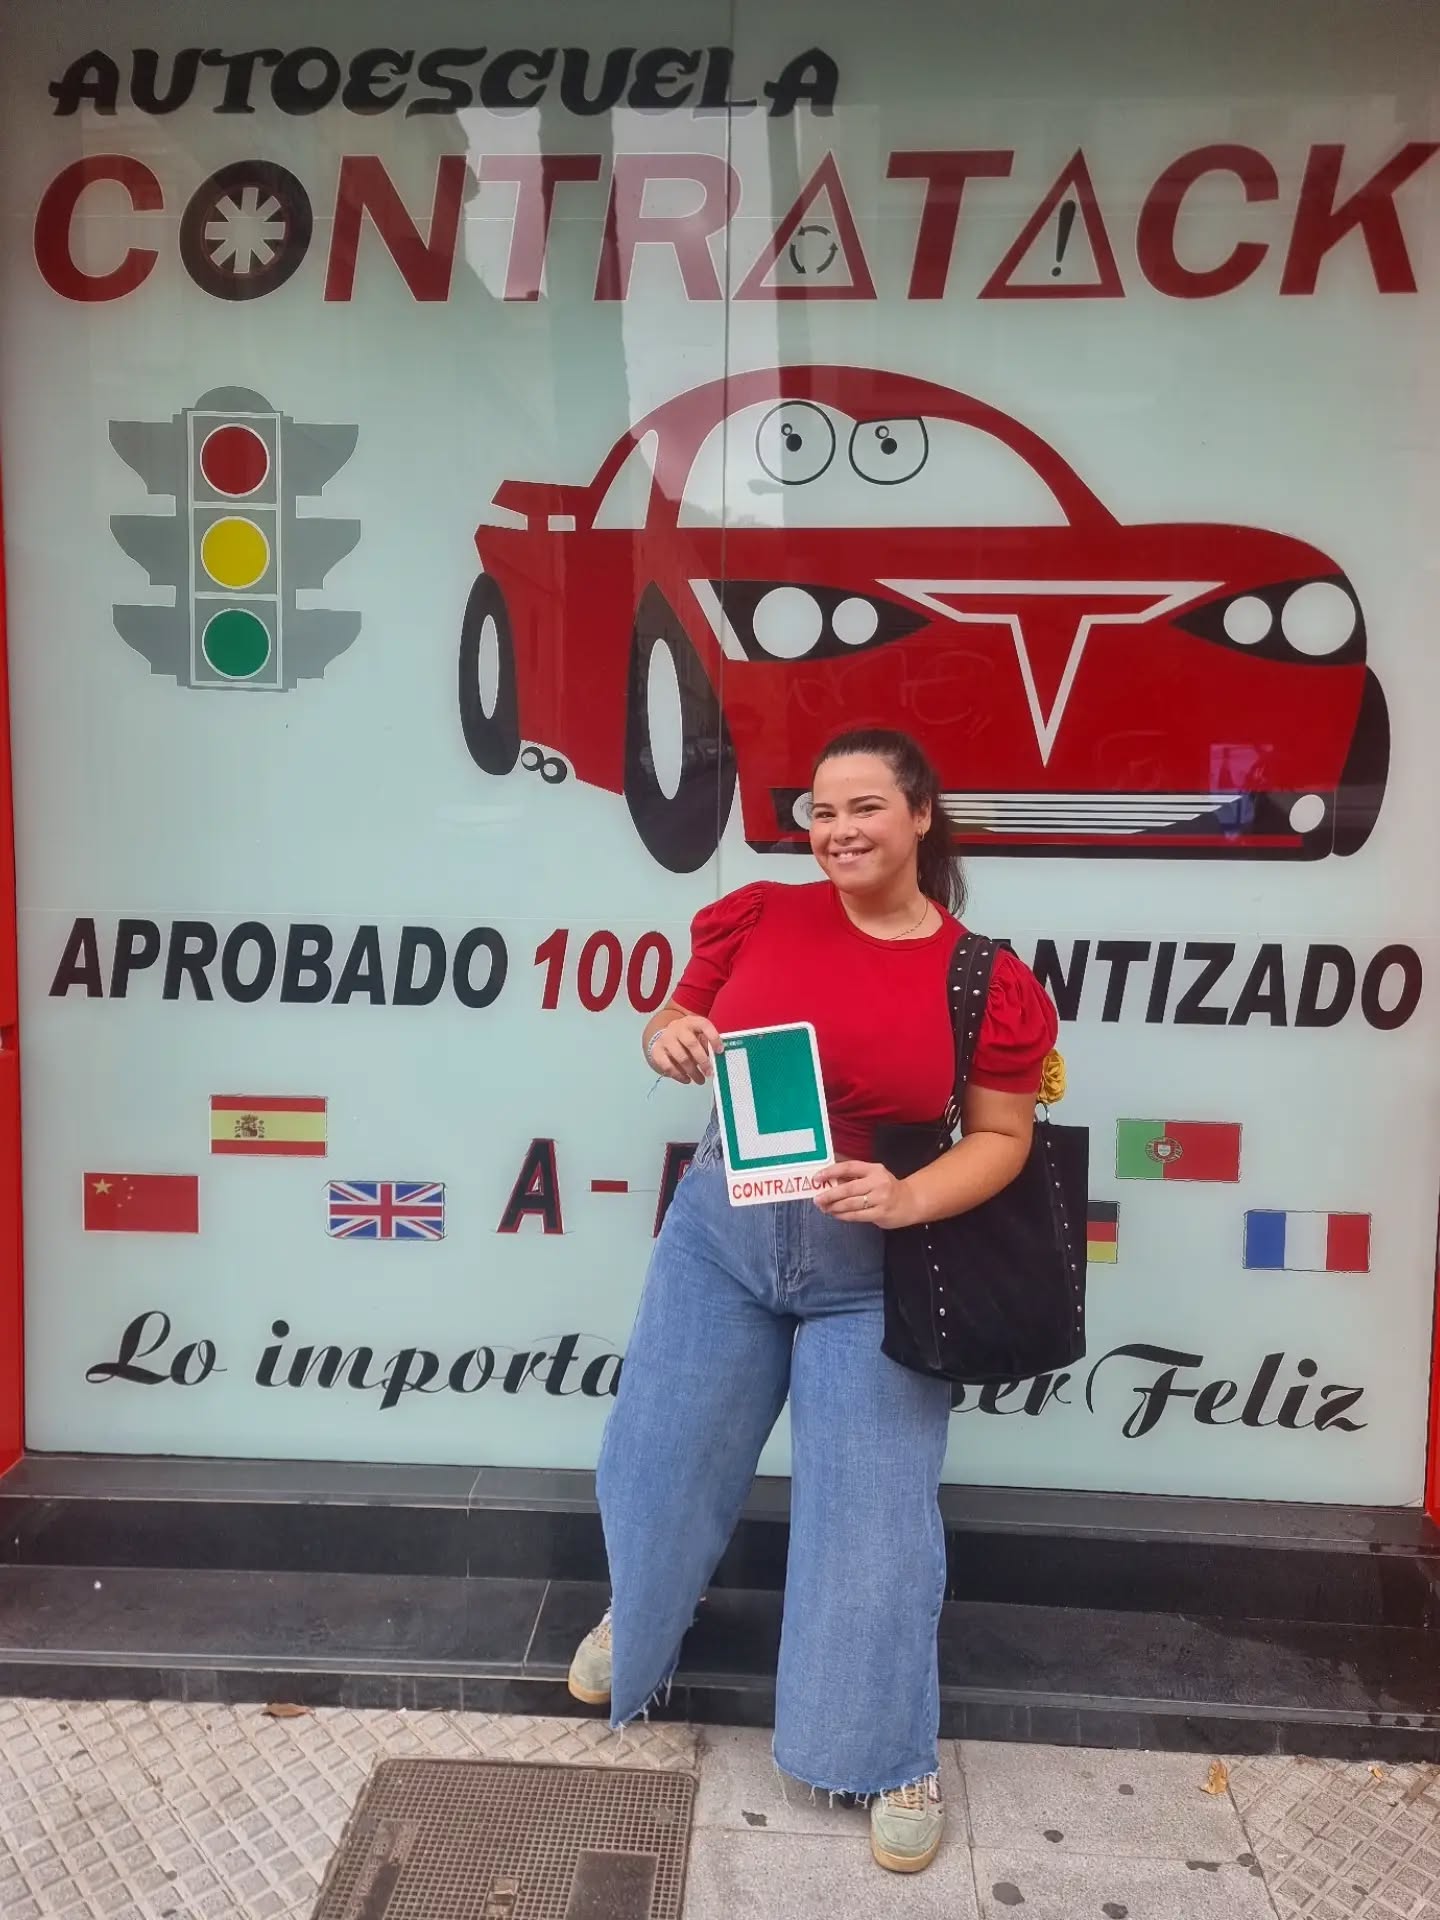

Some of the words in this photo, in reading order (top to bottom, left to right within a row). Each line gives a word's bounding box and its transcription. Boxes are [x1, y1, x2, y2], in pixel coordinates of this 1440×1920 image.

[48, 47, 839, 117] AUTOESCUELA
[33, 142, 1440, 303] CONTRATACK
[49, 917, 508, 1009] APROBADO
[534, 928, 673, 1013] 100
[992, 938, 1423, 1031] NTIZADO
[725, 1047, 817, 1161] L
[496, 1138, 564, 1234] A
[85, 1311, 227, 1386] Lo
[1085, 1343, 1369, 1439] Feliz
